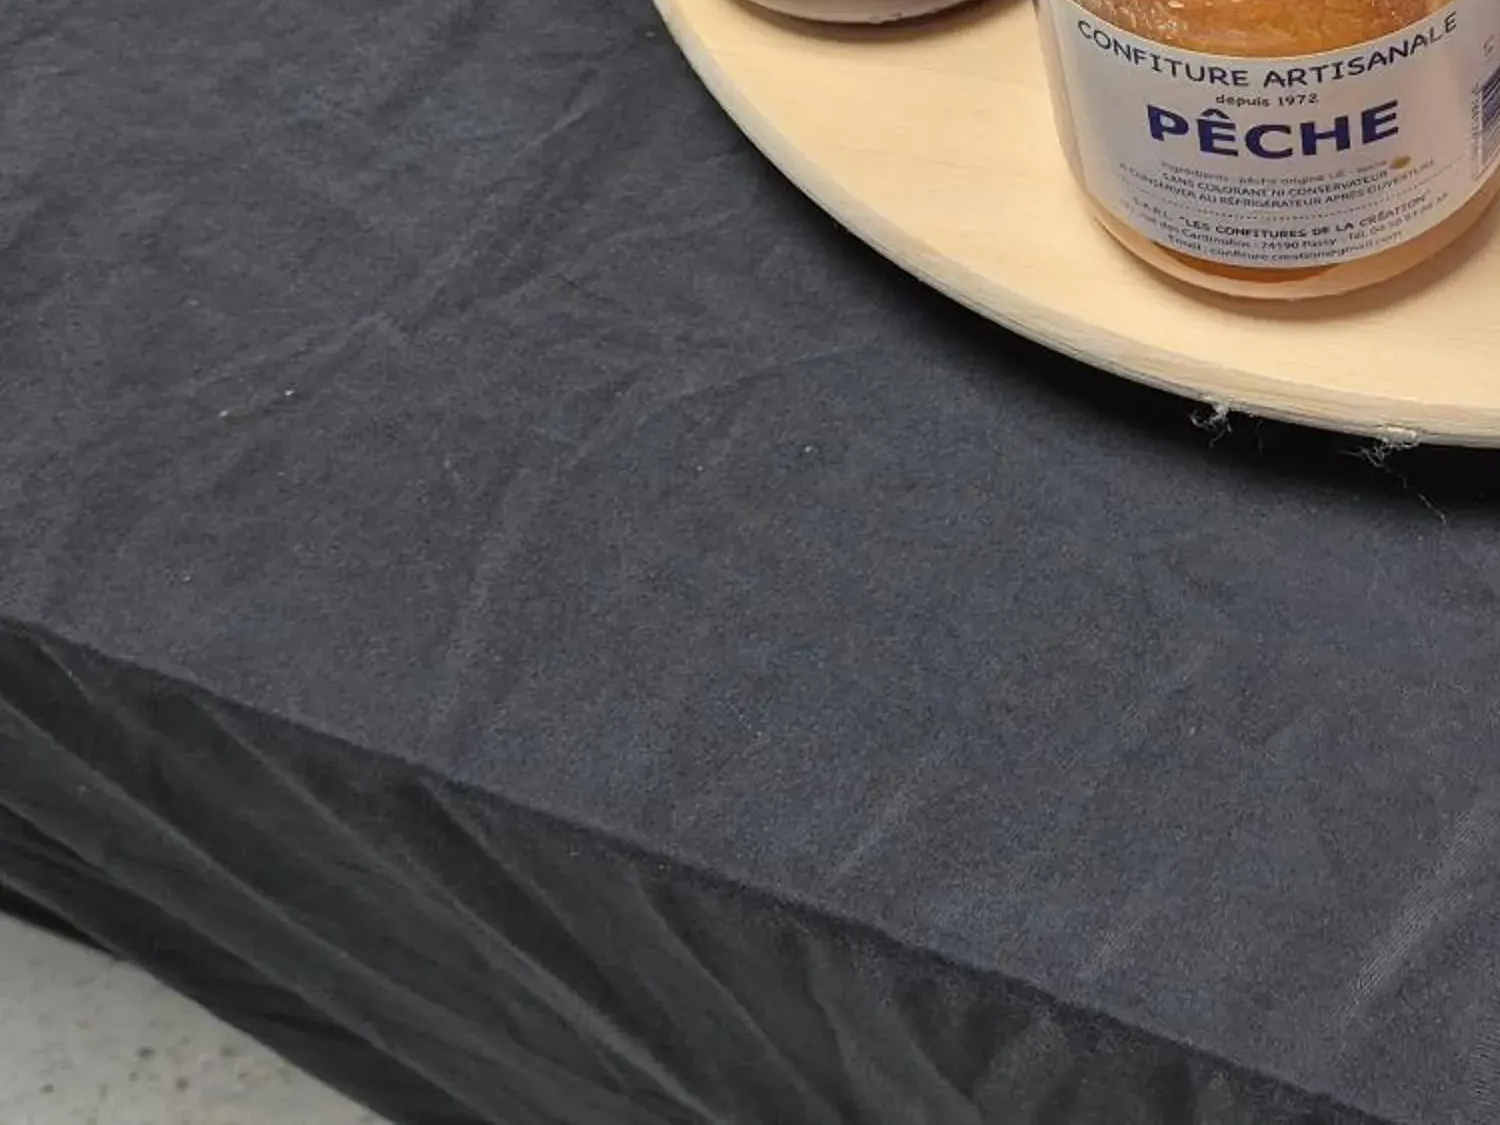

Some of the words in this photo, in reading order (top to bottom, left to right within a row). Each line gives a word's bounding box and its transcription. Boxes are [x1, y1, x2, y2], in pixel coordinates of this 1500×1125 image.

[1077, 19, 1249, 87] CONFITURE
[1263, 10, 1458, 89] ARTISANALE
[1215, 93, 1271, 109] depuis
[1278, 92, 1320, 107] 1972
[1146, 100, 1400, 160] PÊCHE
[1288, 169, 1389, 197] CONSERVATEUR
[1215, 224, 1308, 239] CONFITURES
[1311, 225, 1331, 237] DE
[1335, 221, 1355, 232] LA
